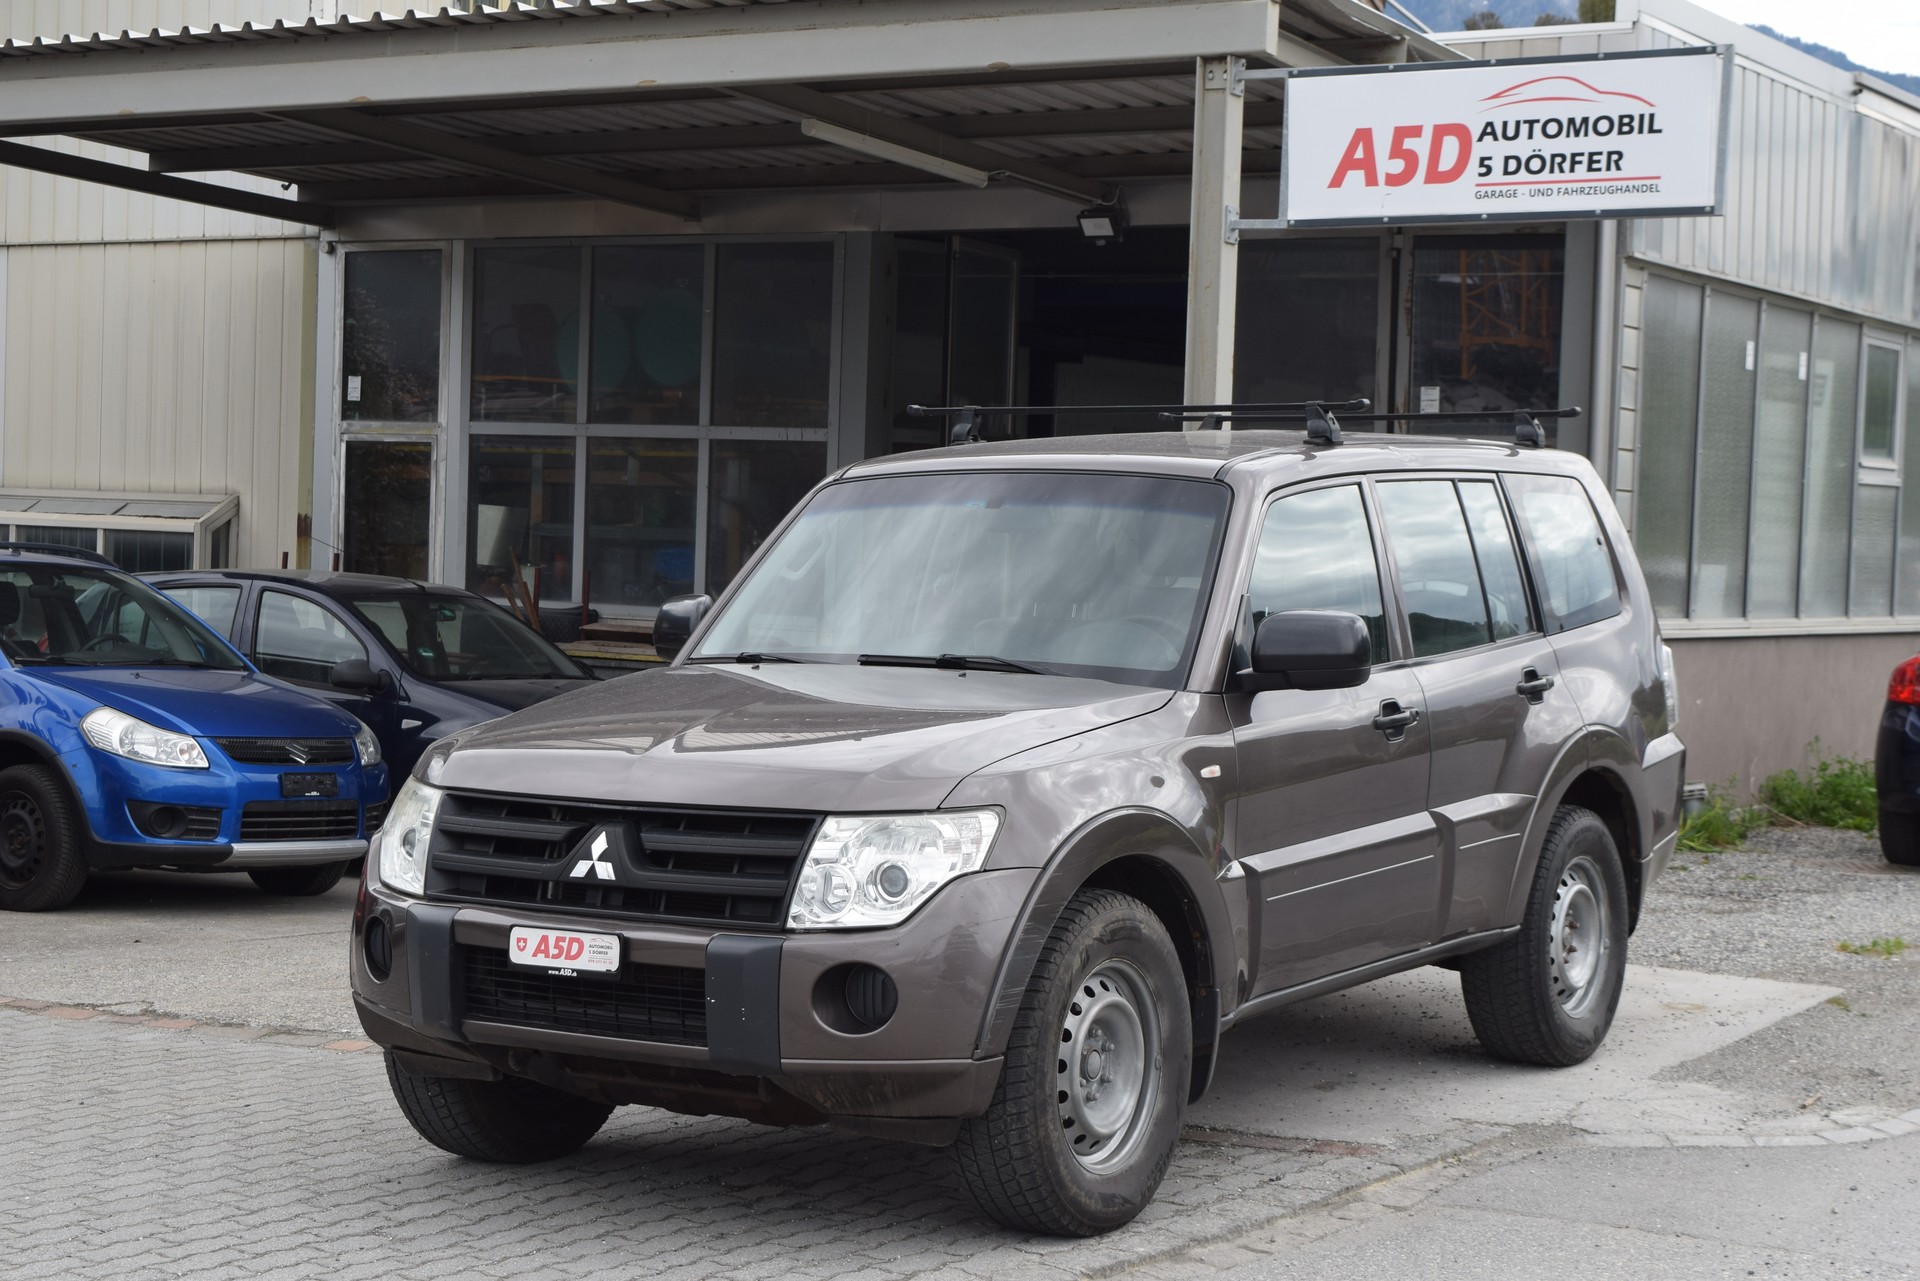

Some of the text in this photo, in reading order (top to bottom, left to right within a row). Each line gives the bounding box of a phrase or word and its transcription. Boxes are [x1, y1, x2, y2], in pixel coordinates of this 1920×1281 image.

[1476, 112, 1663, 143] AUTOMOBIL
[1327, 122, 1473, 189] A5D
[1477, 148, 1625, 177] 5 DÖRFER
[1474, 188, 1519, 200] GARAGE
[1528, 187, 1554, 198] UND
[1556, 183, 1661, 197] FAHRZEUGHANDEL
[531, 934, 585, 961] A5D
